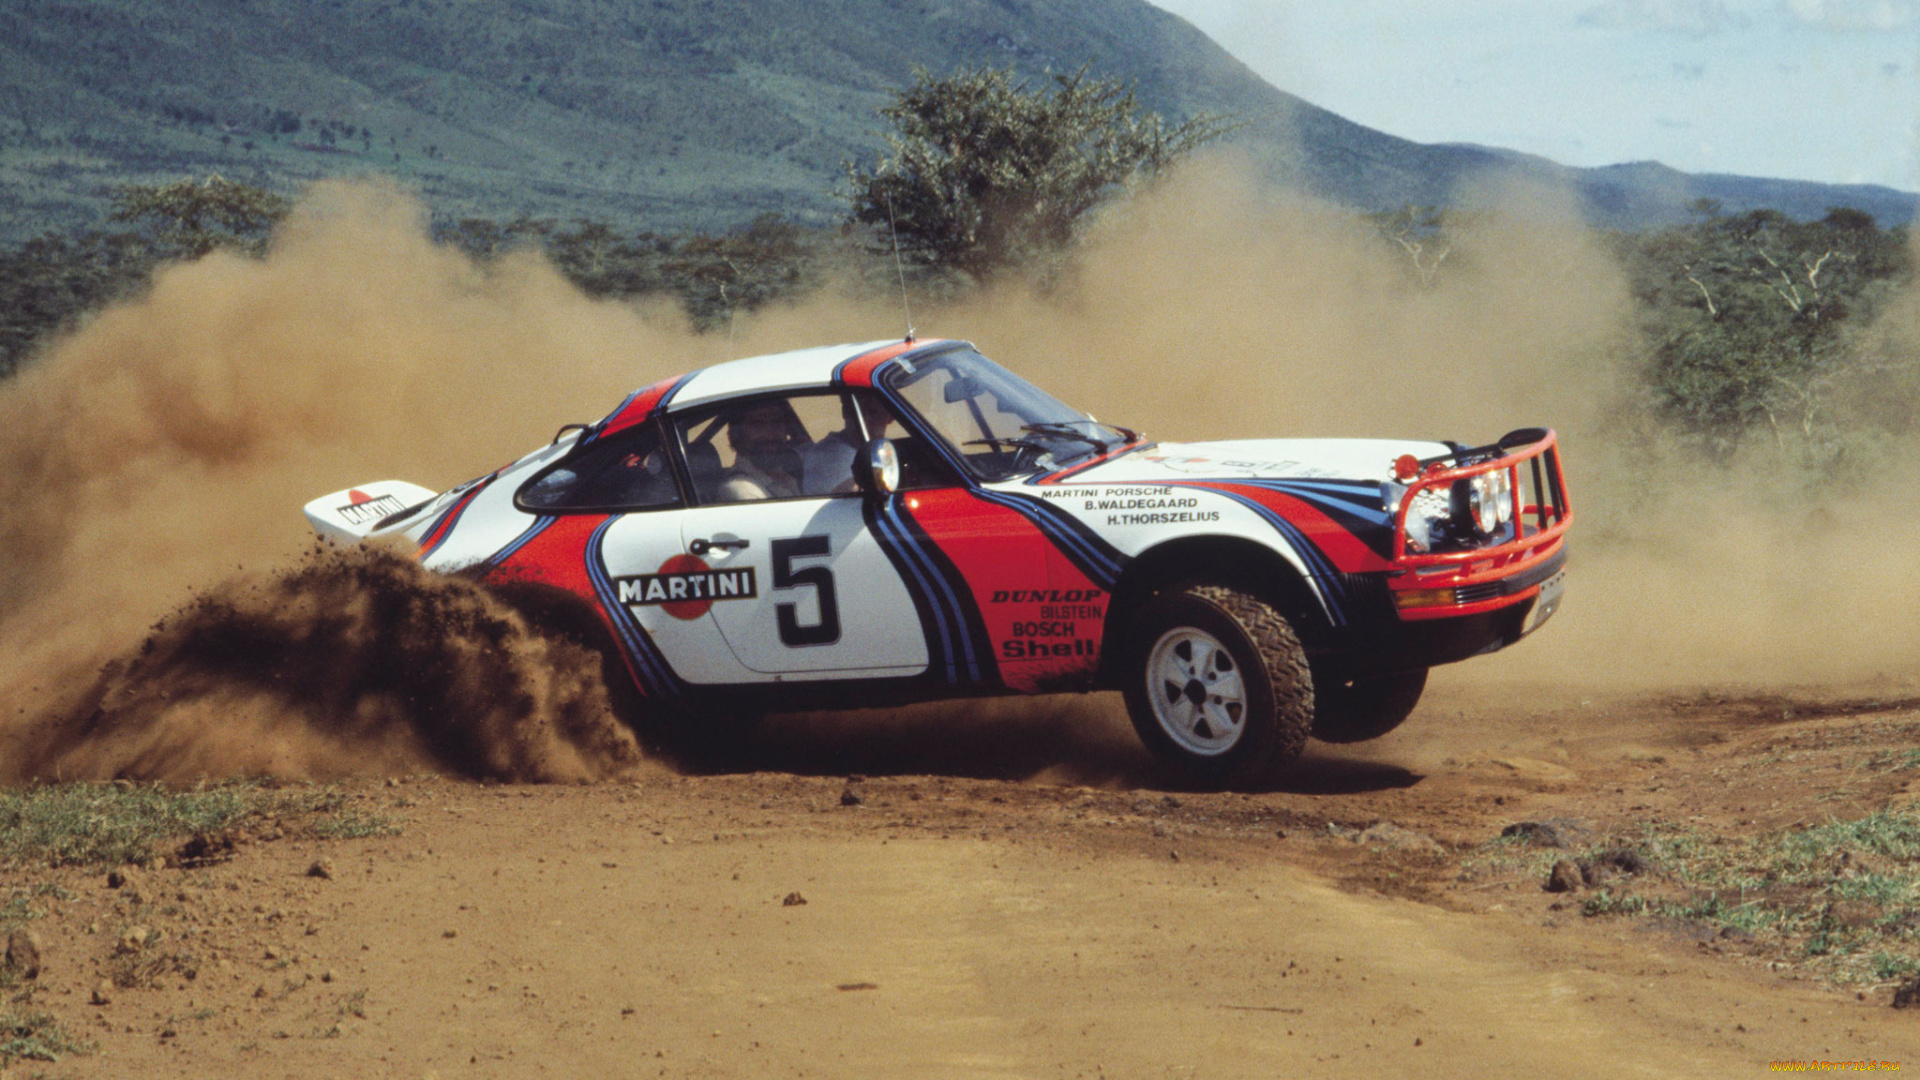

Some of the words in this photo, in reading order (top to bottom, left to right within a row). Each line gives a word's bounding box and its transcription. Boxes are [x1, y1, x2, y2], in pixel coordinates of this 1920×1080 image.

[1041, 488, 1098, 498] MARTINI
[1105, 486, 1173, 497] PORSCHE
[1085, 498, 1198, 511] B.WALDEGAARD
[1107, 511, 1220, 526] H.THORSZELIUS
[619, 572, 751, 603] MARTINI
[770, 534, 842, 648] 5
[990, 589, 1102, 603] DUNLOP
[1041, 605, 1102, 620] BILSTEIN
[1012, 621, 1075, 638] BOSCH
[1003, 639, 1094, 658] Shell
